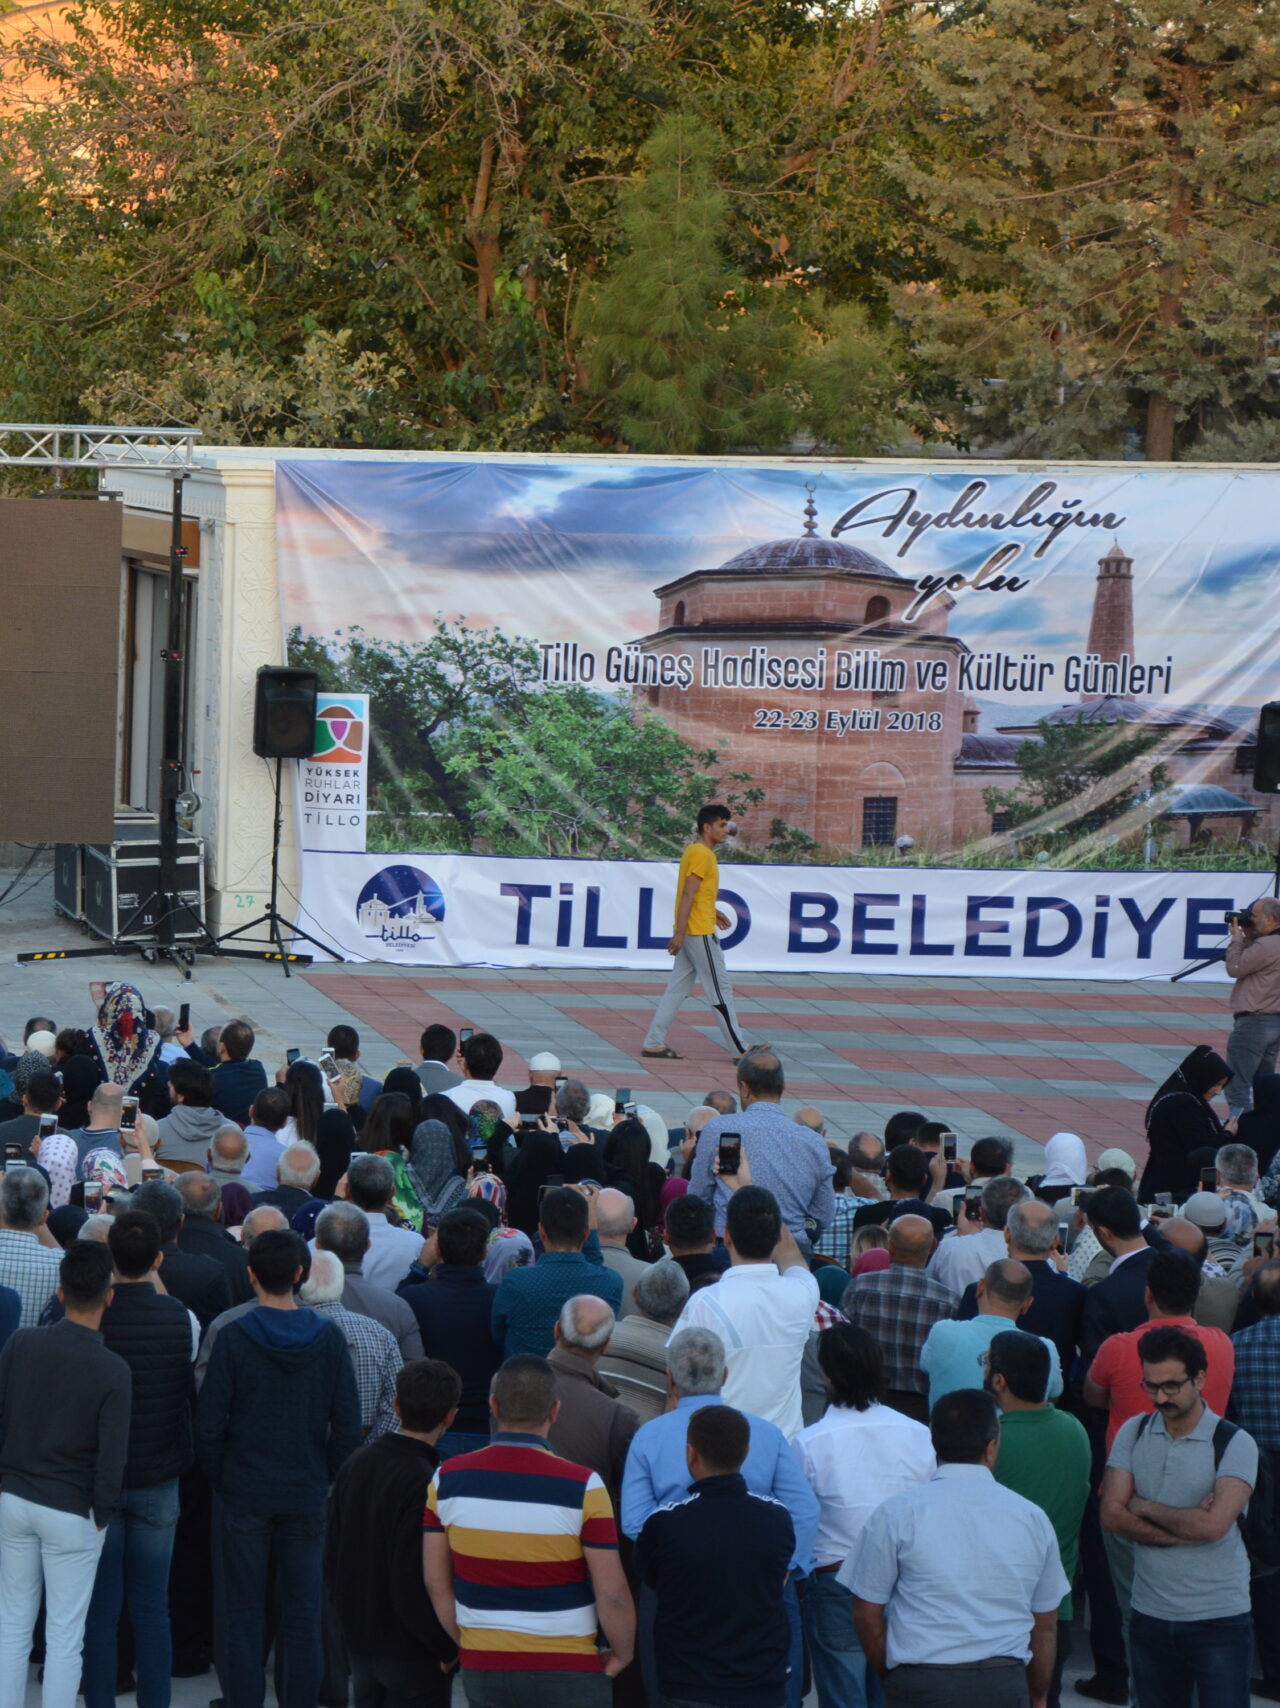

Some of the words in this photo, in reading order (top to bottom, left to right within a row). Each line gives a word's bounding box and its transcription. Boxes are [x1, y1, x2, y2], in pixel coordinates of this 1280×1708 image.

[830, 480, 1127, 558] Aydınlığın
[903, 542, 1030, 621] yolu
[539, 642, 595, 682] Tillo
[605, 646, 694, 689] Güneş
[703, 649, 825, 688] Hadisesi
[836, 650, 907, 690] Bilim
[917, 660, 948, 690] ve
[958, 654, 1054, 692] Kültür
[1064, 655, 1173, 695] Günleri
[754, 709, 818, 729] 22-23
[826, 710, 881, 736] Eylül
[887, 712, 943, 732] 2018
[306, 766, 360, 777] YÜKSEK
[305, 777, 361, 790] RUHLAR
[234, 894, 255, 908] 27
[381, 924, 421, 942] tillo
